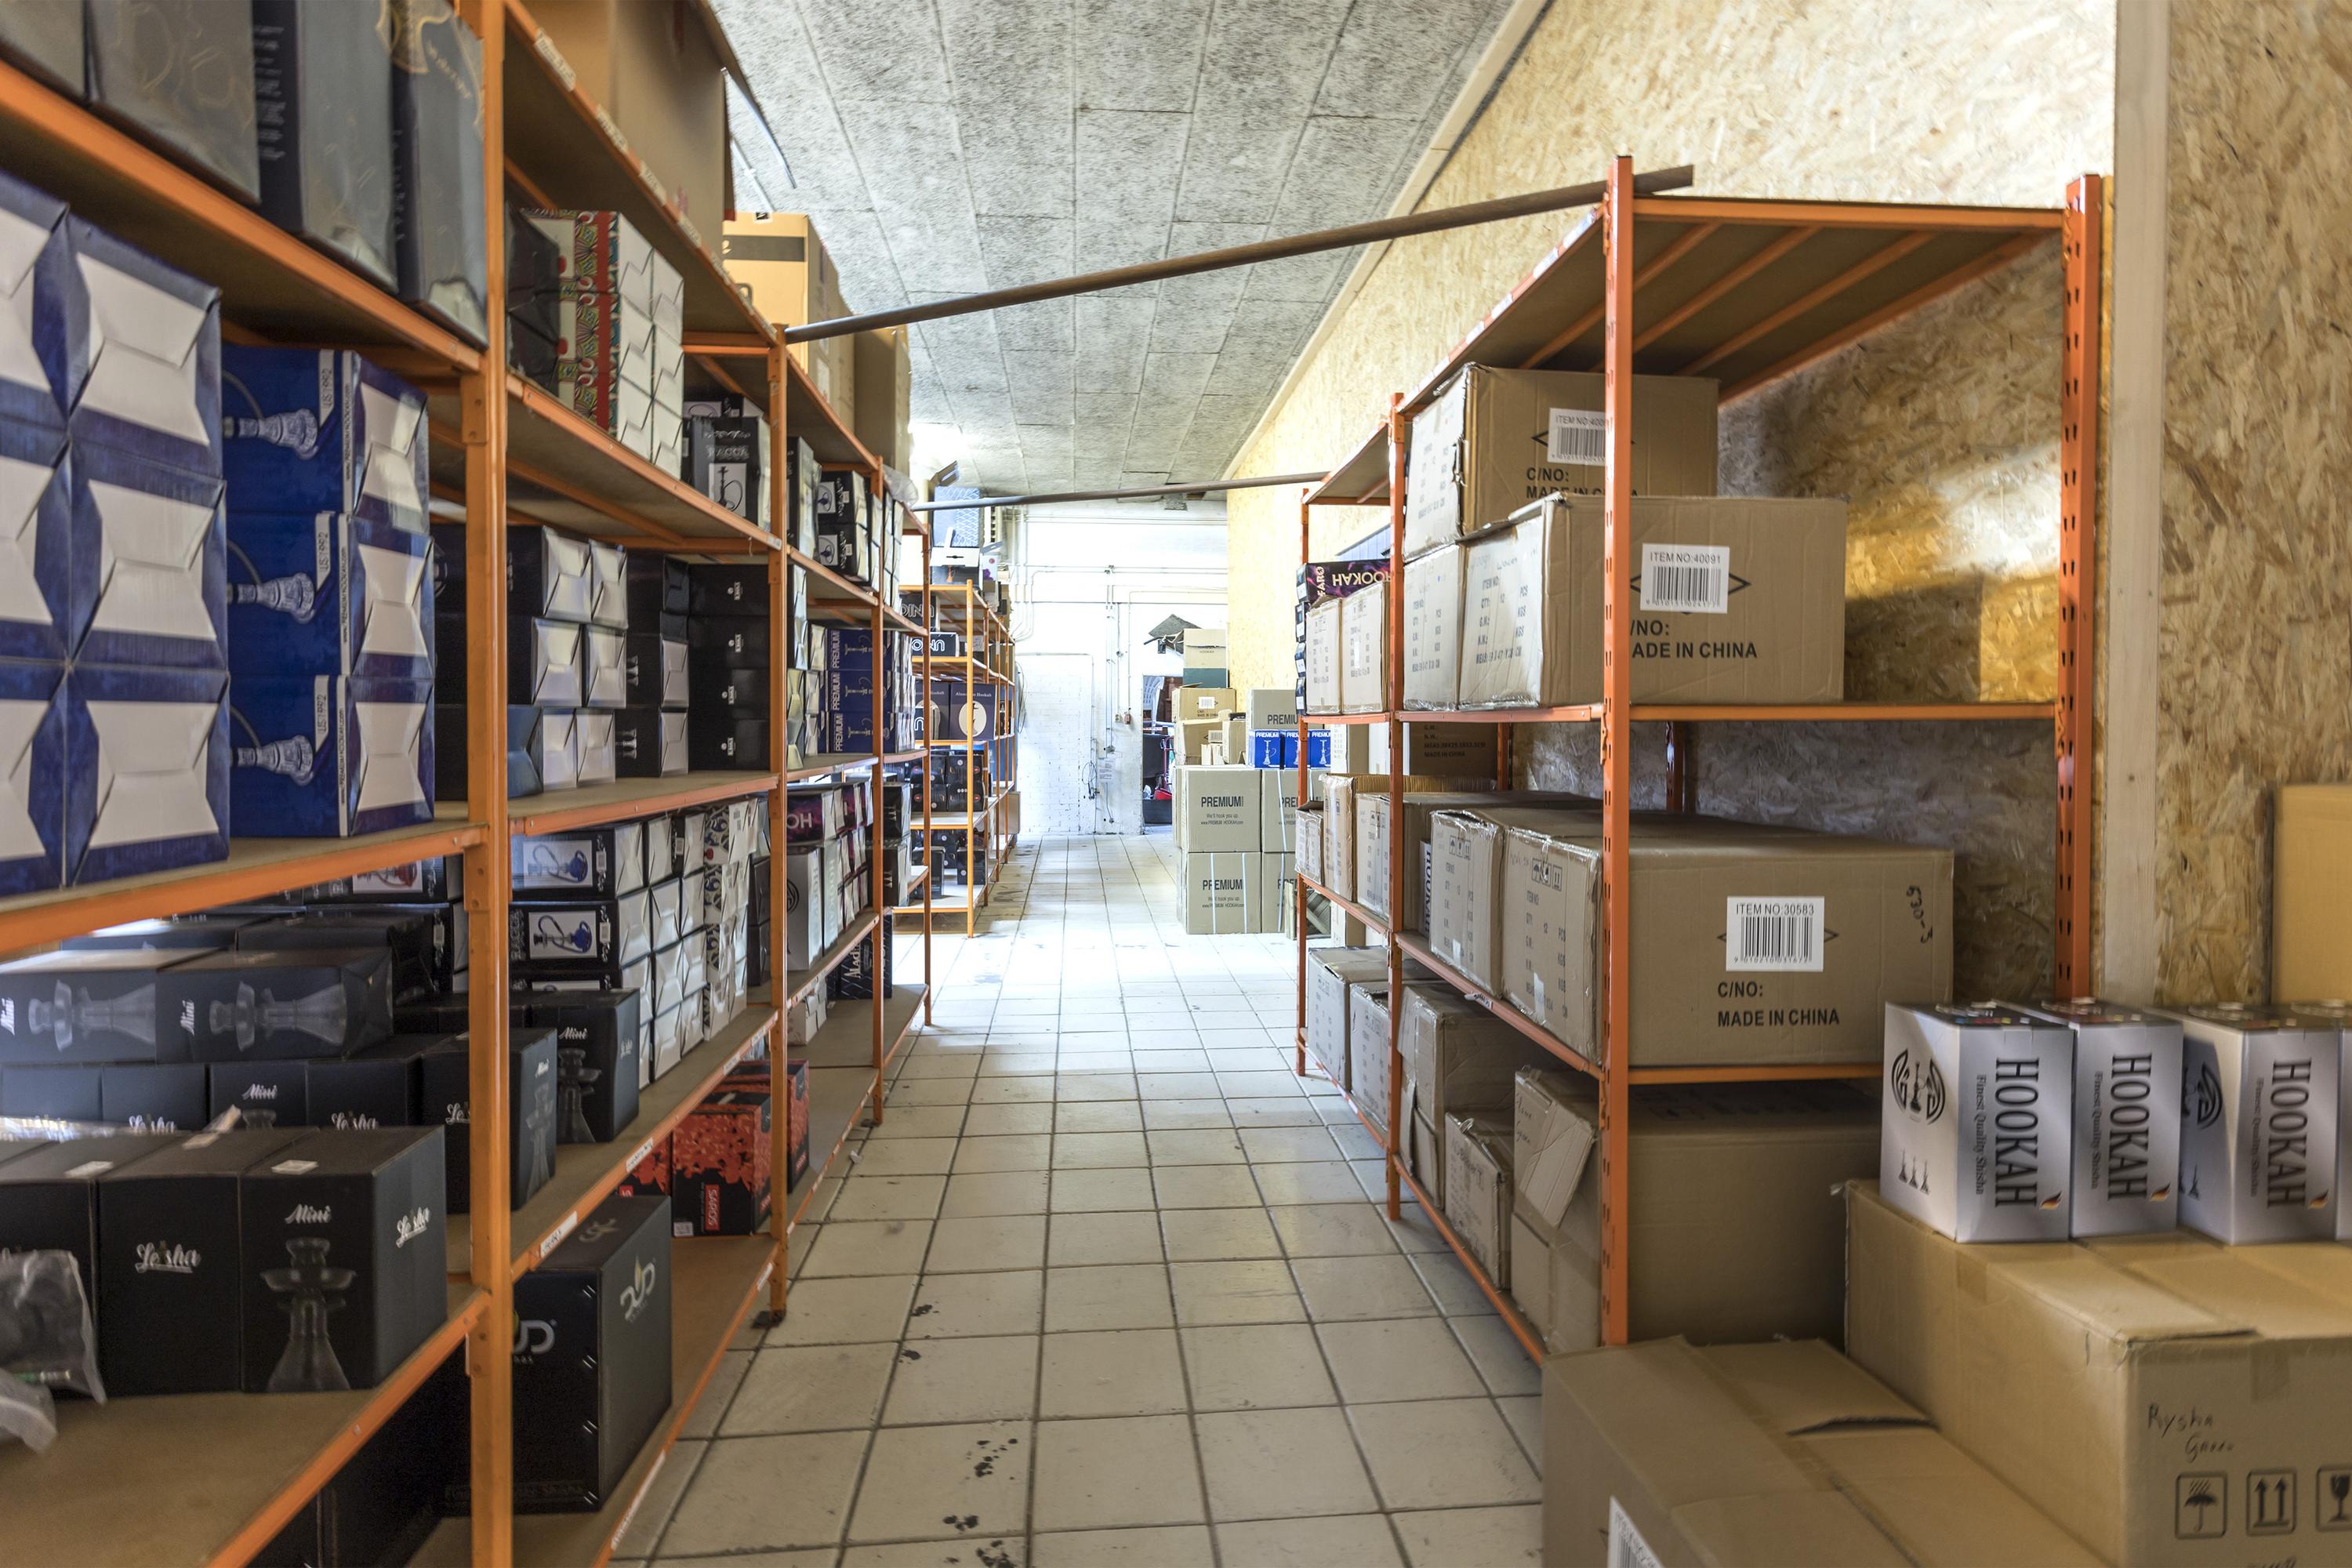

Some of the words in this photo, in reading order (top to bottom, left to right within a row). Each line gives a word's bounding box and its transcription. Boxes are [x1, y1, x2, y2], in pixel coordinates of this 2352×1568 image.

[1526, 468, 1569, 481] C/NO:
[1650, 552, 1674, 562] ITEM
[1631, 620, 1669, 636] /NO:
[1632, 643, 1671, 659] ADE
[1676, 643, 1693, 659] IN
[1700, 643, 1758, 659] CHINA
[1267, 714, 1298, 725] PREMIU
[834, 714, 843, 752] PREMIUM
[1201, 796, 1241, 808] PREMIUM
[1736, 903, 1762, 916] ITEM
[1765, 903, 1816, 916] NO:30583
[1718, 982, 1763, 998] C/NO:
[1718, 1011, 1764, 1027] MADE
[1769, 1011, 1784, 1026] IN
[1788, 1008, 1840, 1025] CHINA
[558, 1027, 588, 1040] Mini
[242, 1083, 277, 1100] Mini
[1976, 1075, 1987, 1110] Finest
[1973, 1112, 1987, 1152] Quality
[1995, 1057, 2039, 1208] HOOKAH
[2091, 1107, 2103, 1149] Quality
[2107, 1053, 2152, 1201] HOOKAH
[2267, 1058, 2312, 1209] HOOKAH
[285, 1203, 331, 1225] Mini
